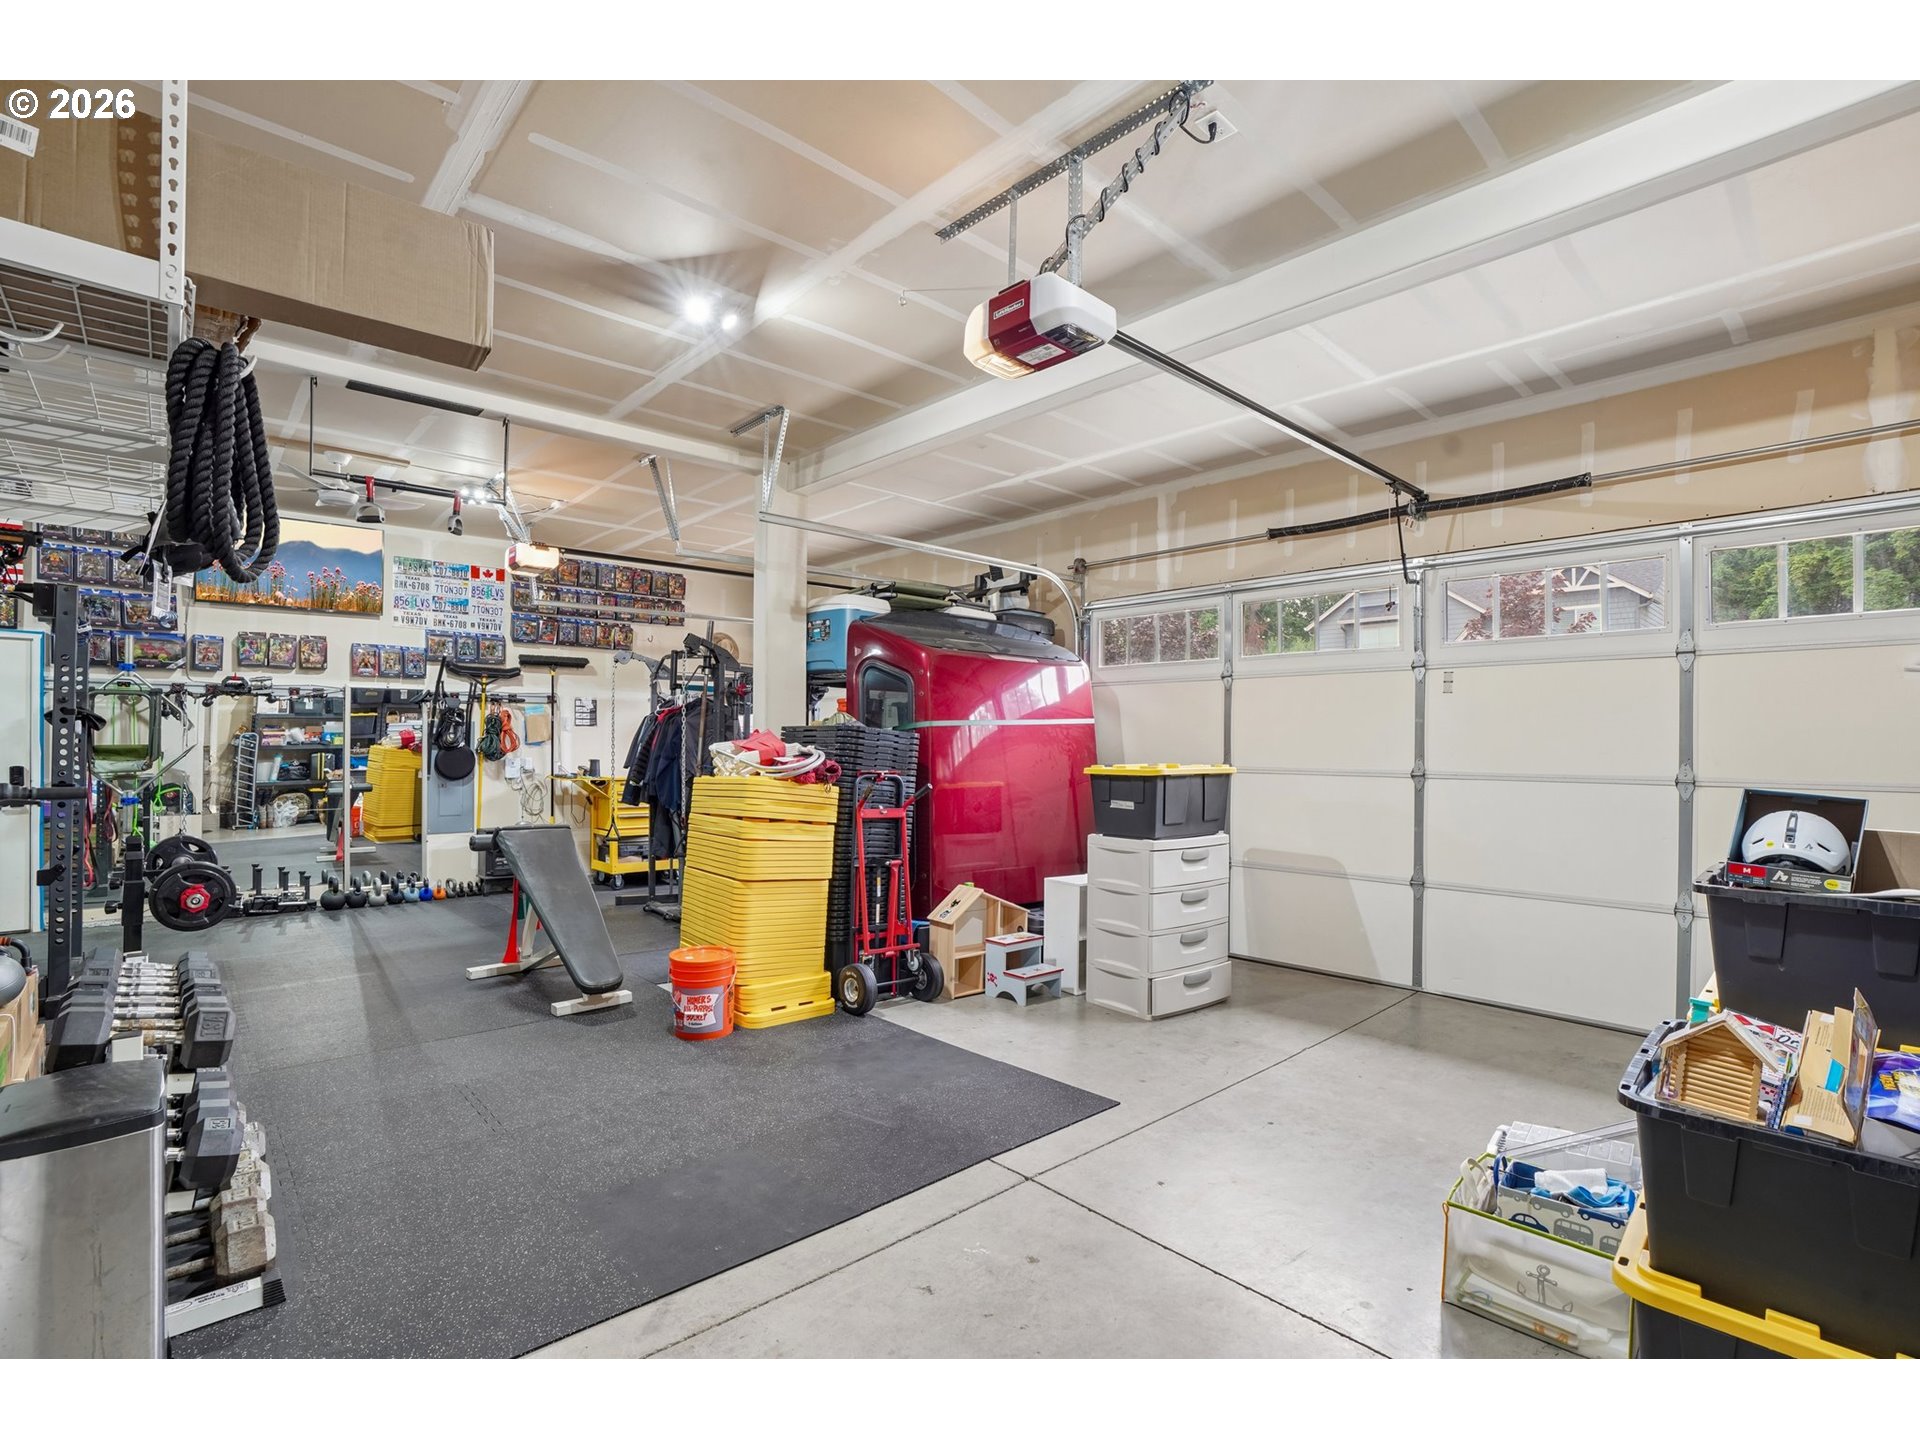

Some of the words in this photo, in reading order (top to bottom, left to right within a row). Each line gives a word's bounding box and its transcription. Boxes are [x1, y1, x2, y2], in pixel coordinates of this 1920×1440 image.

[397, 561, 429, 573] ALASKA
[471, 585, 486, 597] 856
[489, 588, 505, 598] LVS
[393, 596, 409, 607] 856
[415, 598, 430, 608] LVS
